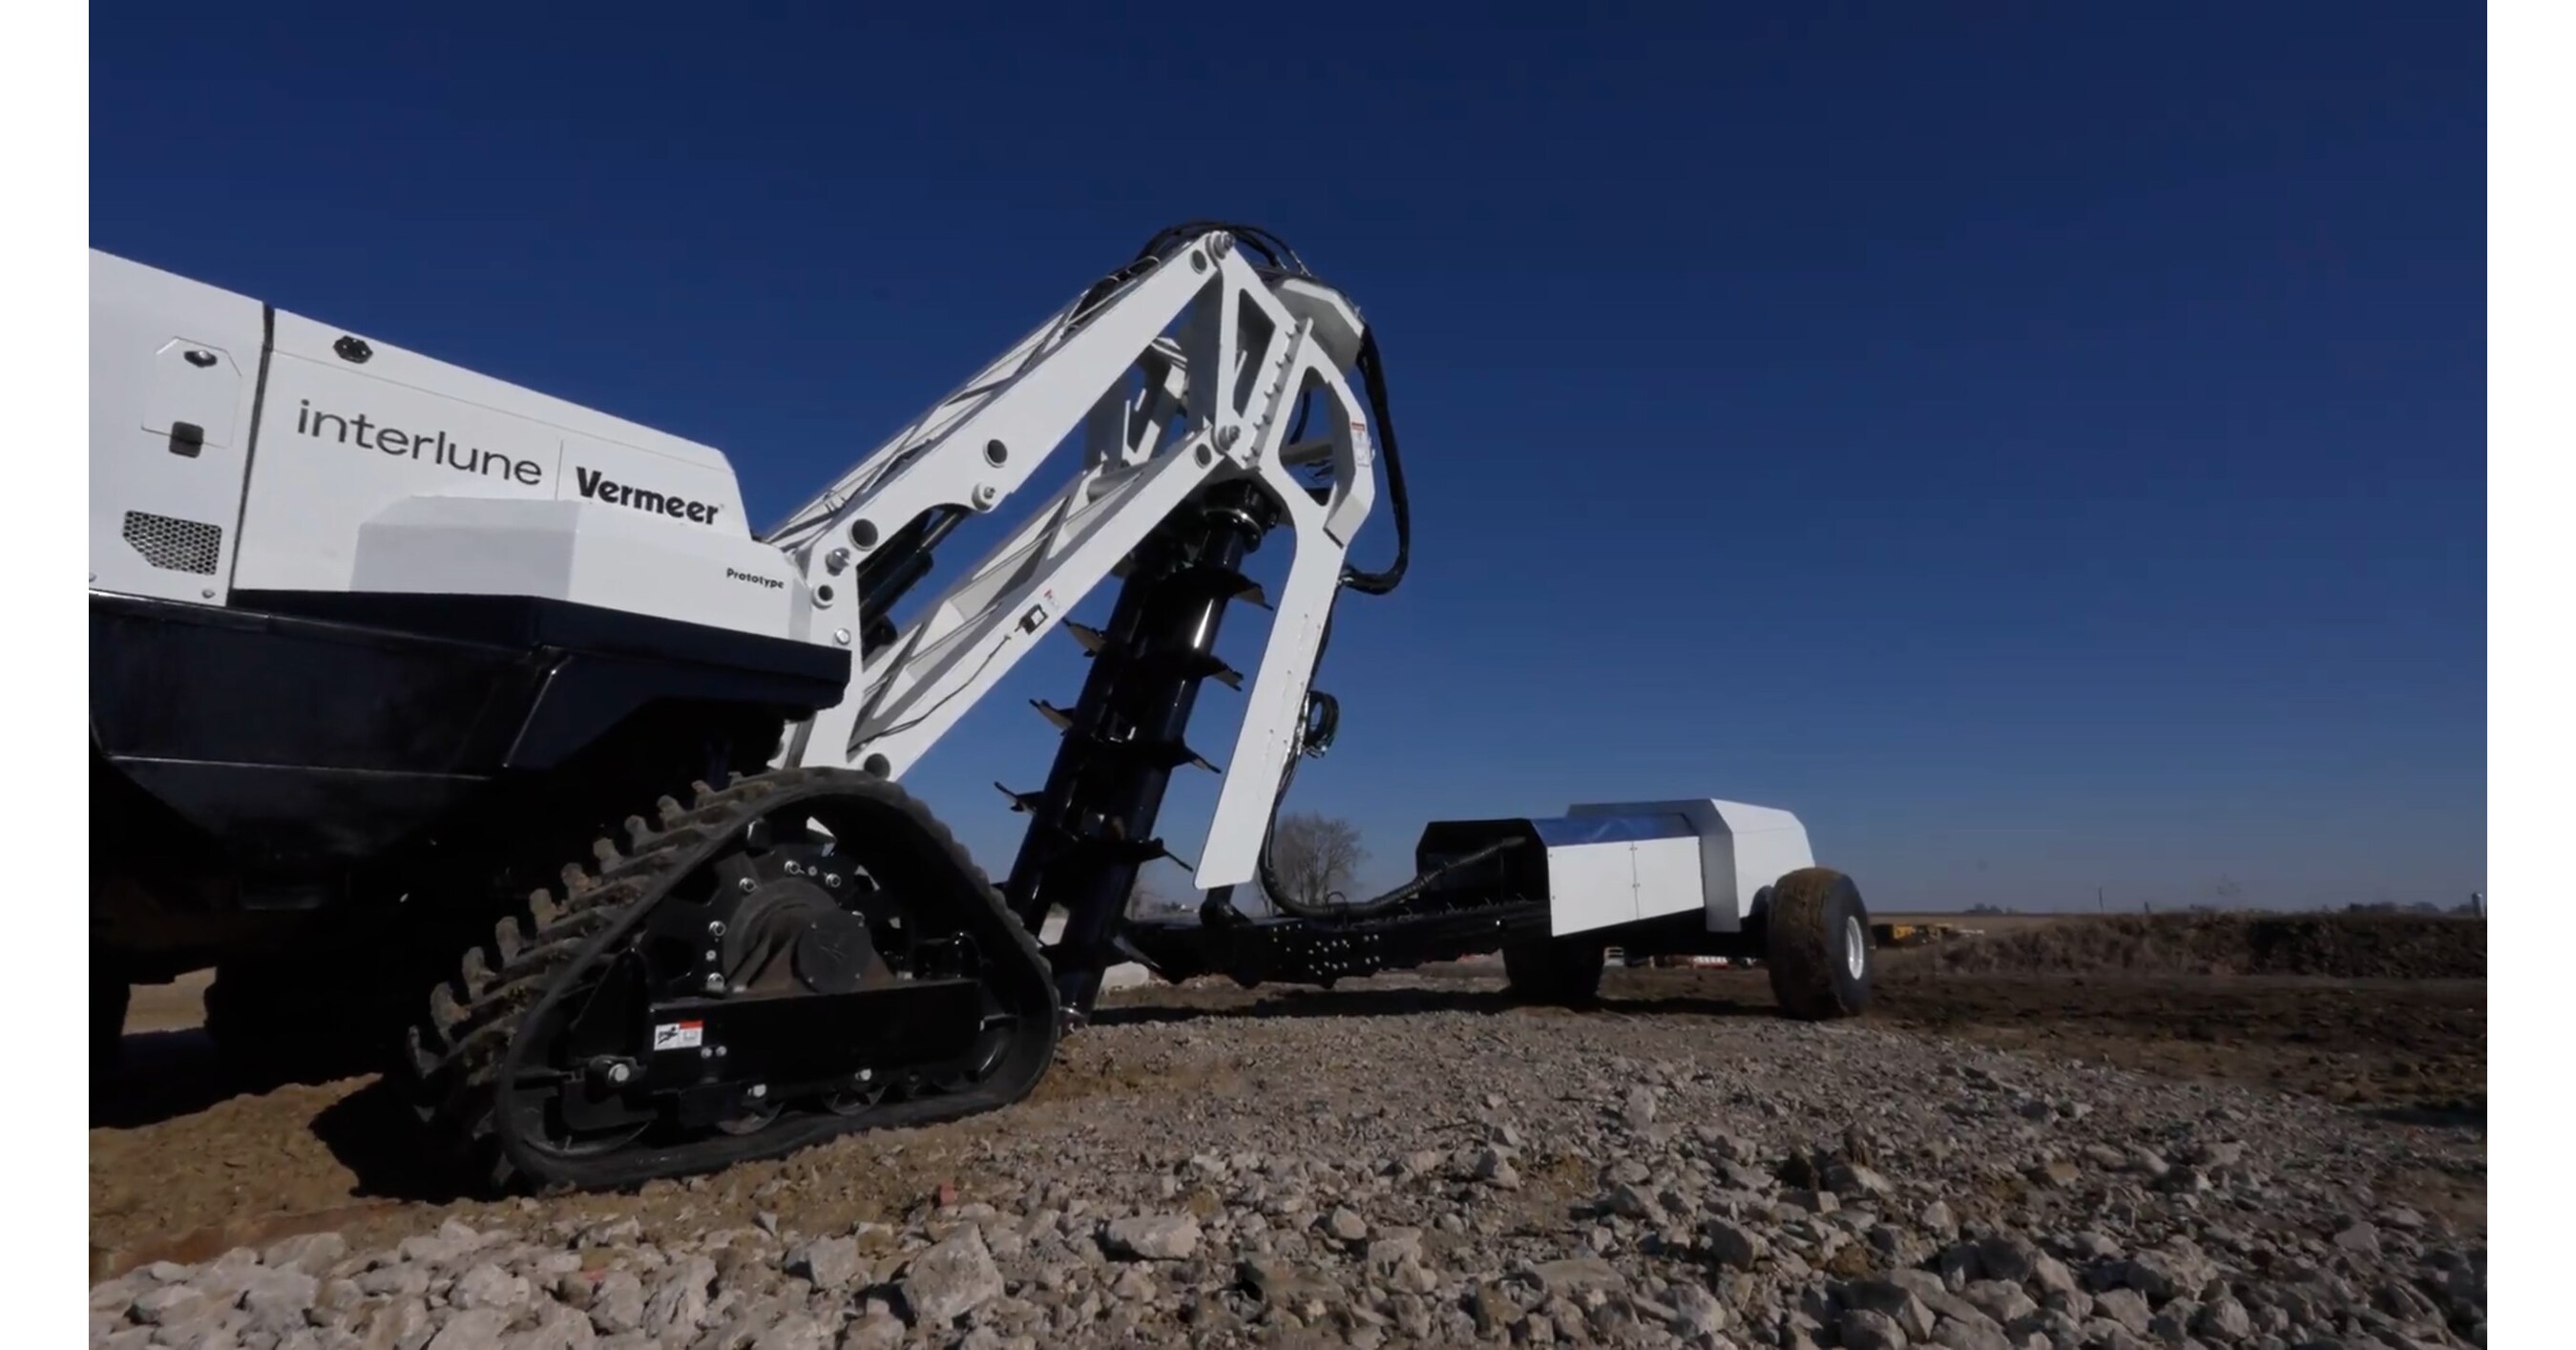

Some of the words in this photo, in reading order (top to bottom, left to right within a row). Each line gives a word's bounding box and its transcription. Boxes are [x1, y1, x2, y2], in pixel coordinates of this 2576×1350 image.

[298, 399, 542, 486] interlune
[576, 466, 719, 525] Vermeer
[726, 567, 784, 589] Prototype
